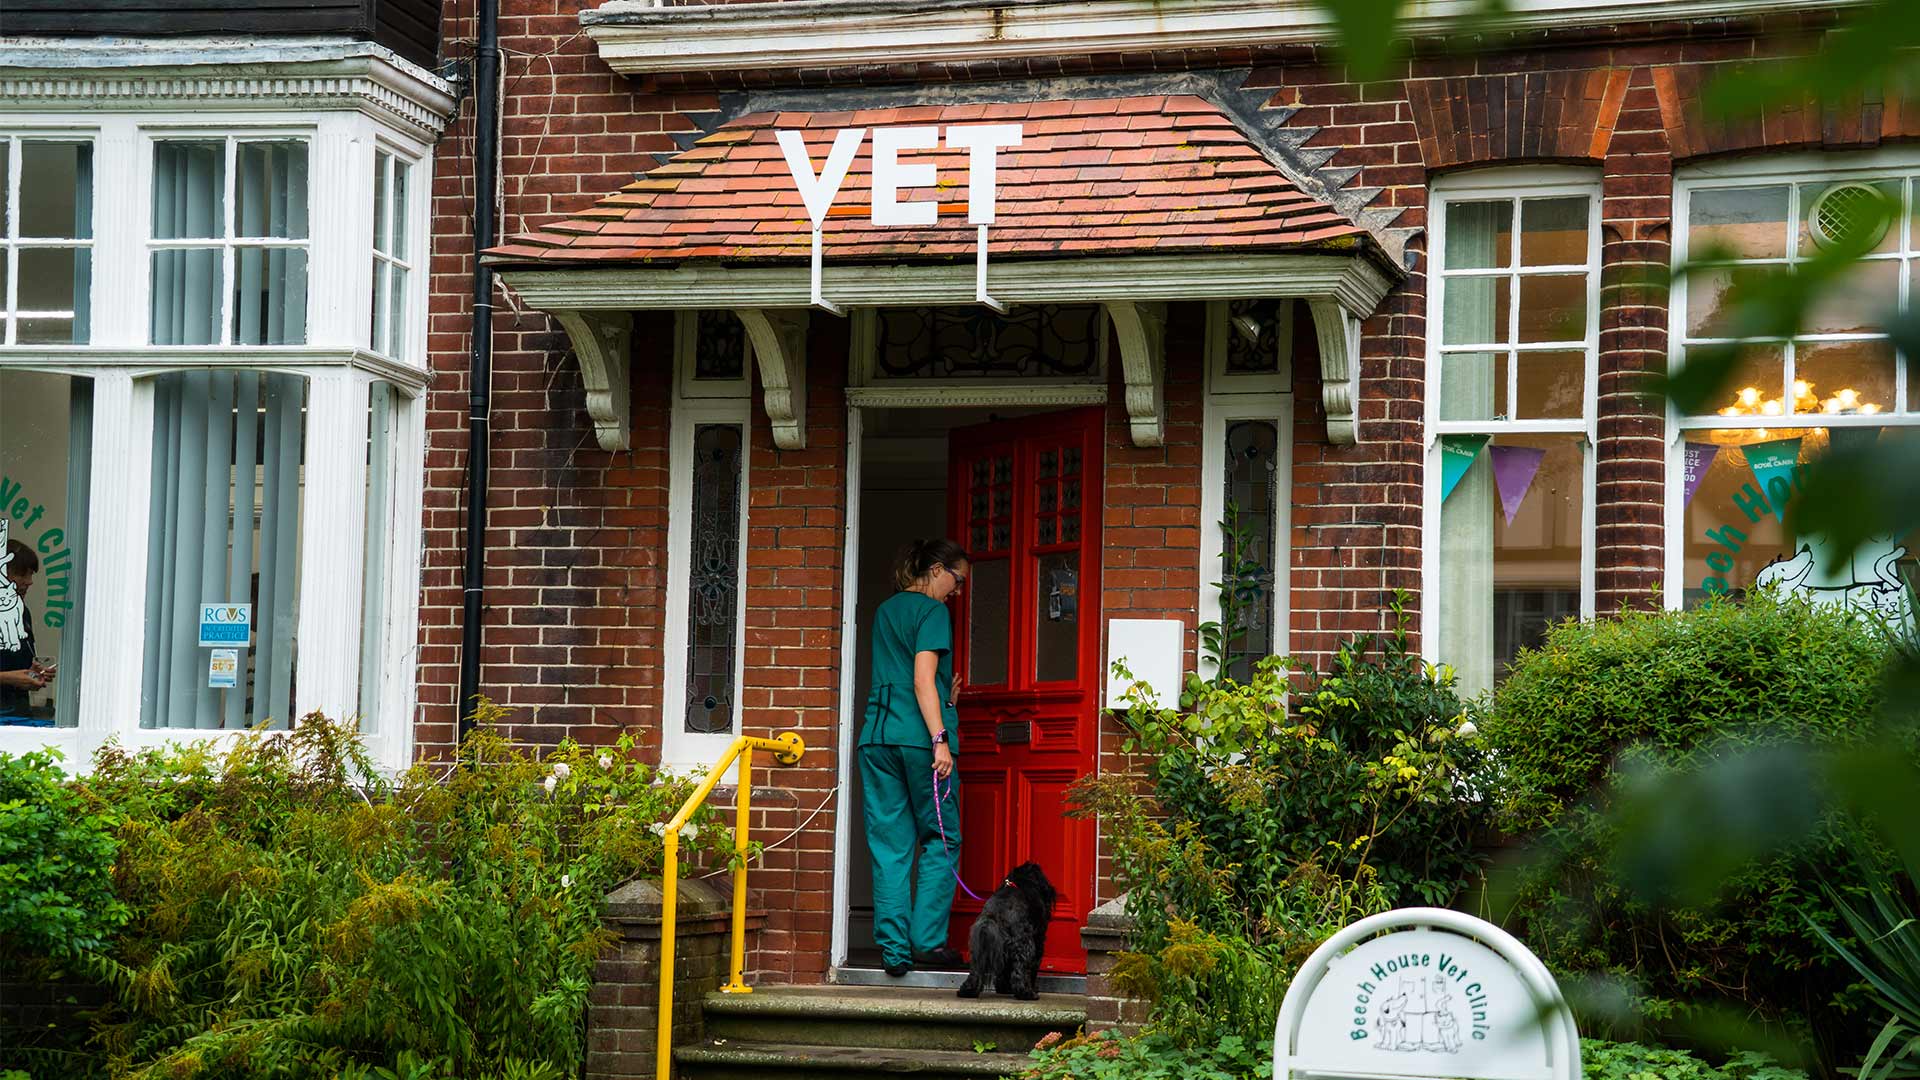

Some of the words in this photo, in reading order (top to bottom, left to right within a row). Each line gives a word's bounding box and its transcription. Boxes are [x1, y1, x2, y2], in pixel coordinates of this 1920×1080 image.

[774, 124, 1023, 231] VET
[1685, 458, 1700, 467] ICE
[1685, 474, 1696, 482] OD
[0, 477, 45, 529] Vet
[38, 528, 73, 628] Clinic
[1701, 524, 1748, 608] ech
[203, 632, 246, 640] PRACTICE
[204, 607, 246, 622] RCVS
[1350, 979, 1375, 1040] Beech
[1370, 952, 1430, 981] House
[1438, 953, 1468, 981] Vet
[1466, 983, 1490, 1040] Clinic
